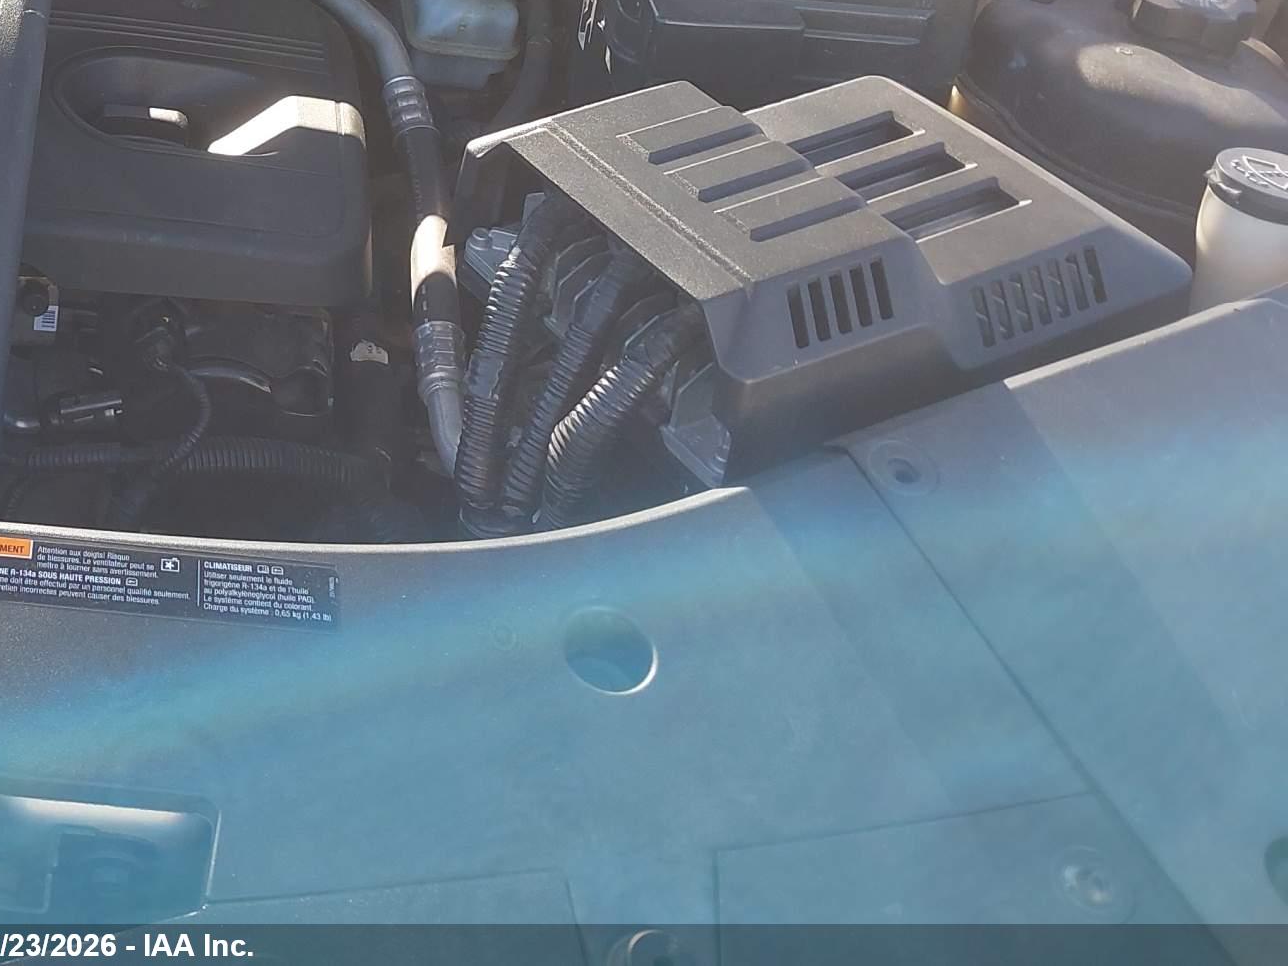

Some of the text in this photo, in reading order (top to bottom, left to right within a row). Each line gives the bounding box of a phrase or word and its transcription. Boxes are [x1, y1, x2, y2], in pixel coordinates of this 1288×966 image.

[38, 546, 67, 555] Attention
[108, 552, 129, 561] Risque
[48, 554, 81, 564] blessures.
[93, 559, 128, 568] ventilateur
[130, 562, 145, 570] peut
[204, 561, 252, 572] CLIMATISEUR
[37, 561, 58, 569] mettre
[67, 564, 90, 572] tourner
[110, 568, 158, 578] avertissement.
[11, 568, 36, 577] R-134a
[38, 571, 57, 579] SOUS
[60, 573, 83, 581] HAUTE
[85, 575, 120, 585] PRESSION
[229, 574, 264, 583] seulement
[274, 577, 292, 585] fluide
[92, 584, 125, 595] personnel
[242, 583, 267, 591] R-134a
[20, 586, 56, 596] incorrectes
[59, 589, 85, 599] peuvent
[88, 592, 109, 600] causer
[204, 603, 228, 613] Charge
[244, 599, 272, 607] contient
